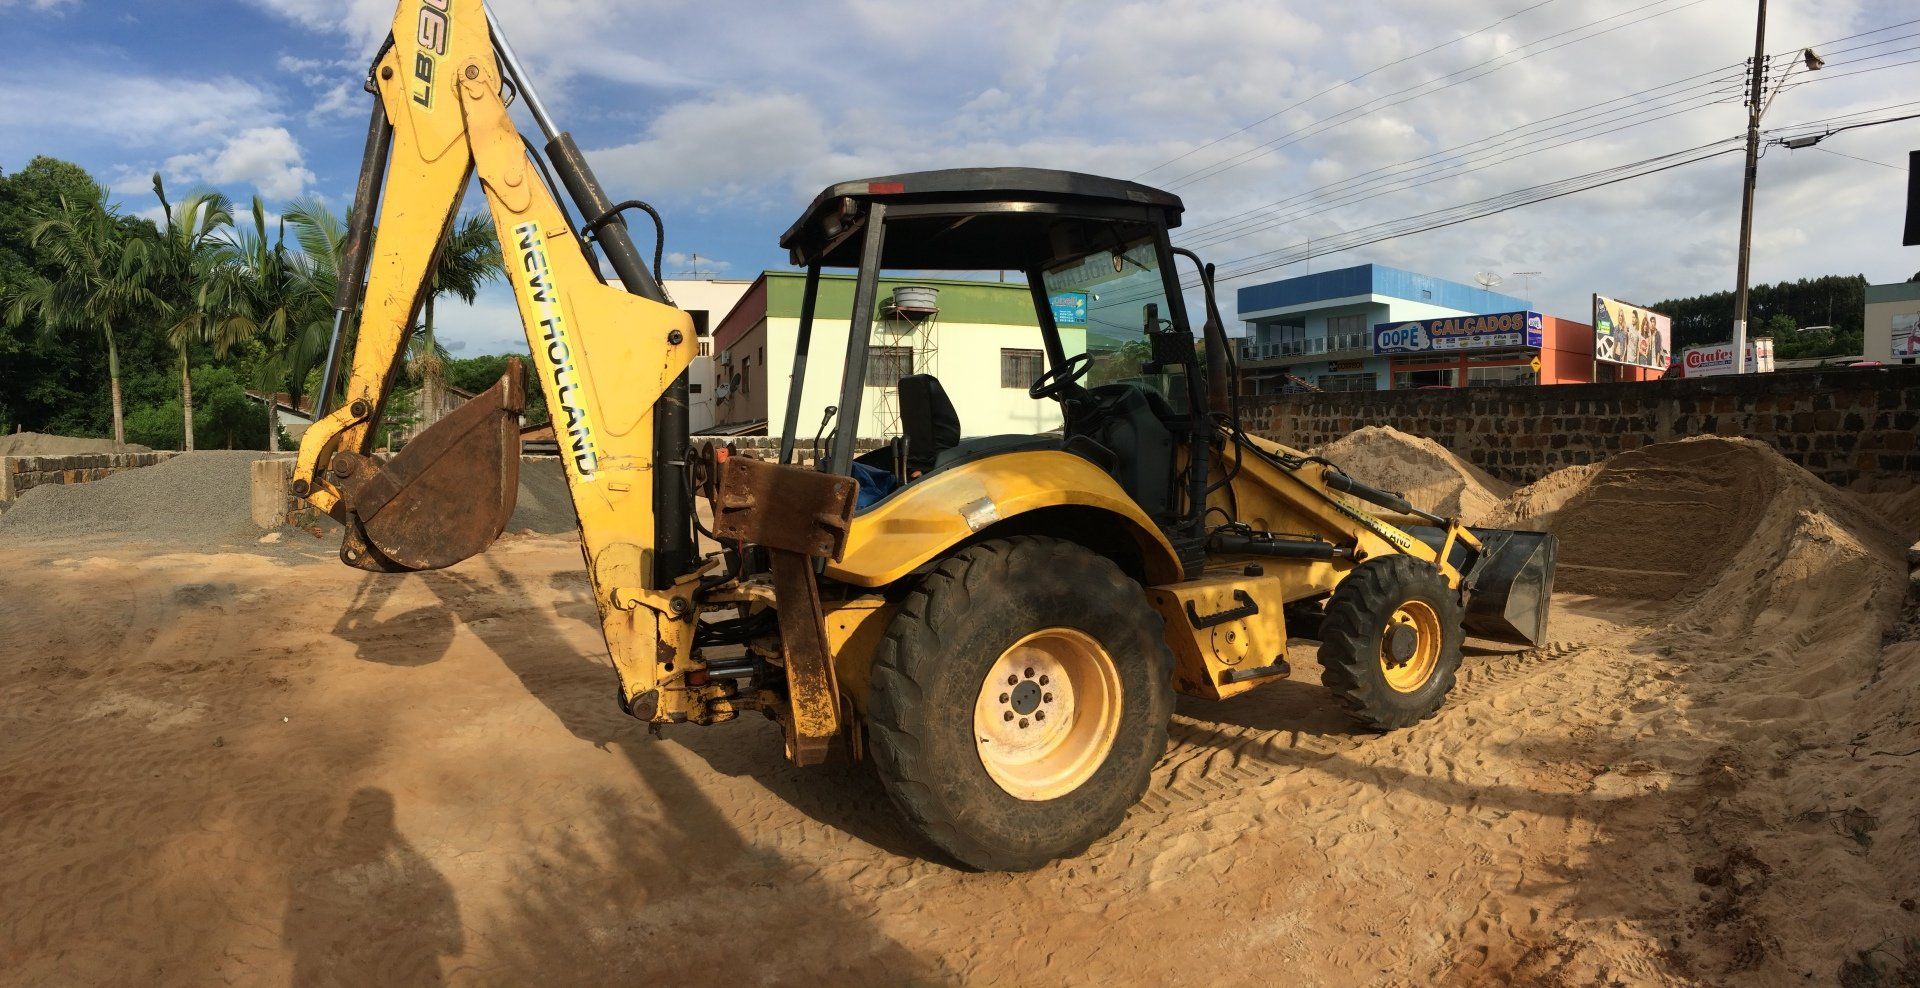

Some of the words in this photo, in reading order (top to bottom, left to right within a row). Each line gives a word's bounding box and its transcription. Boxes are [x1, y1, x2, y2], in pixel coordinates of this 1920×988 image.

[1431, 313, 1523, 336] CALÇADOS
[1382, 326, 1420, 347] DOPÉ
[515, 223, 556, 305] NEW
[540, 316, 599, 476] HOLLAND
